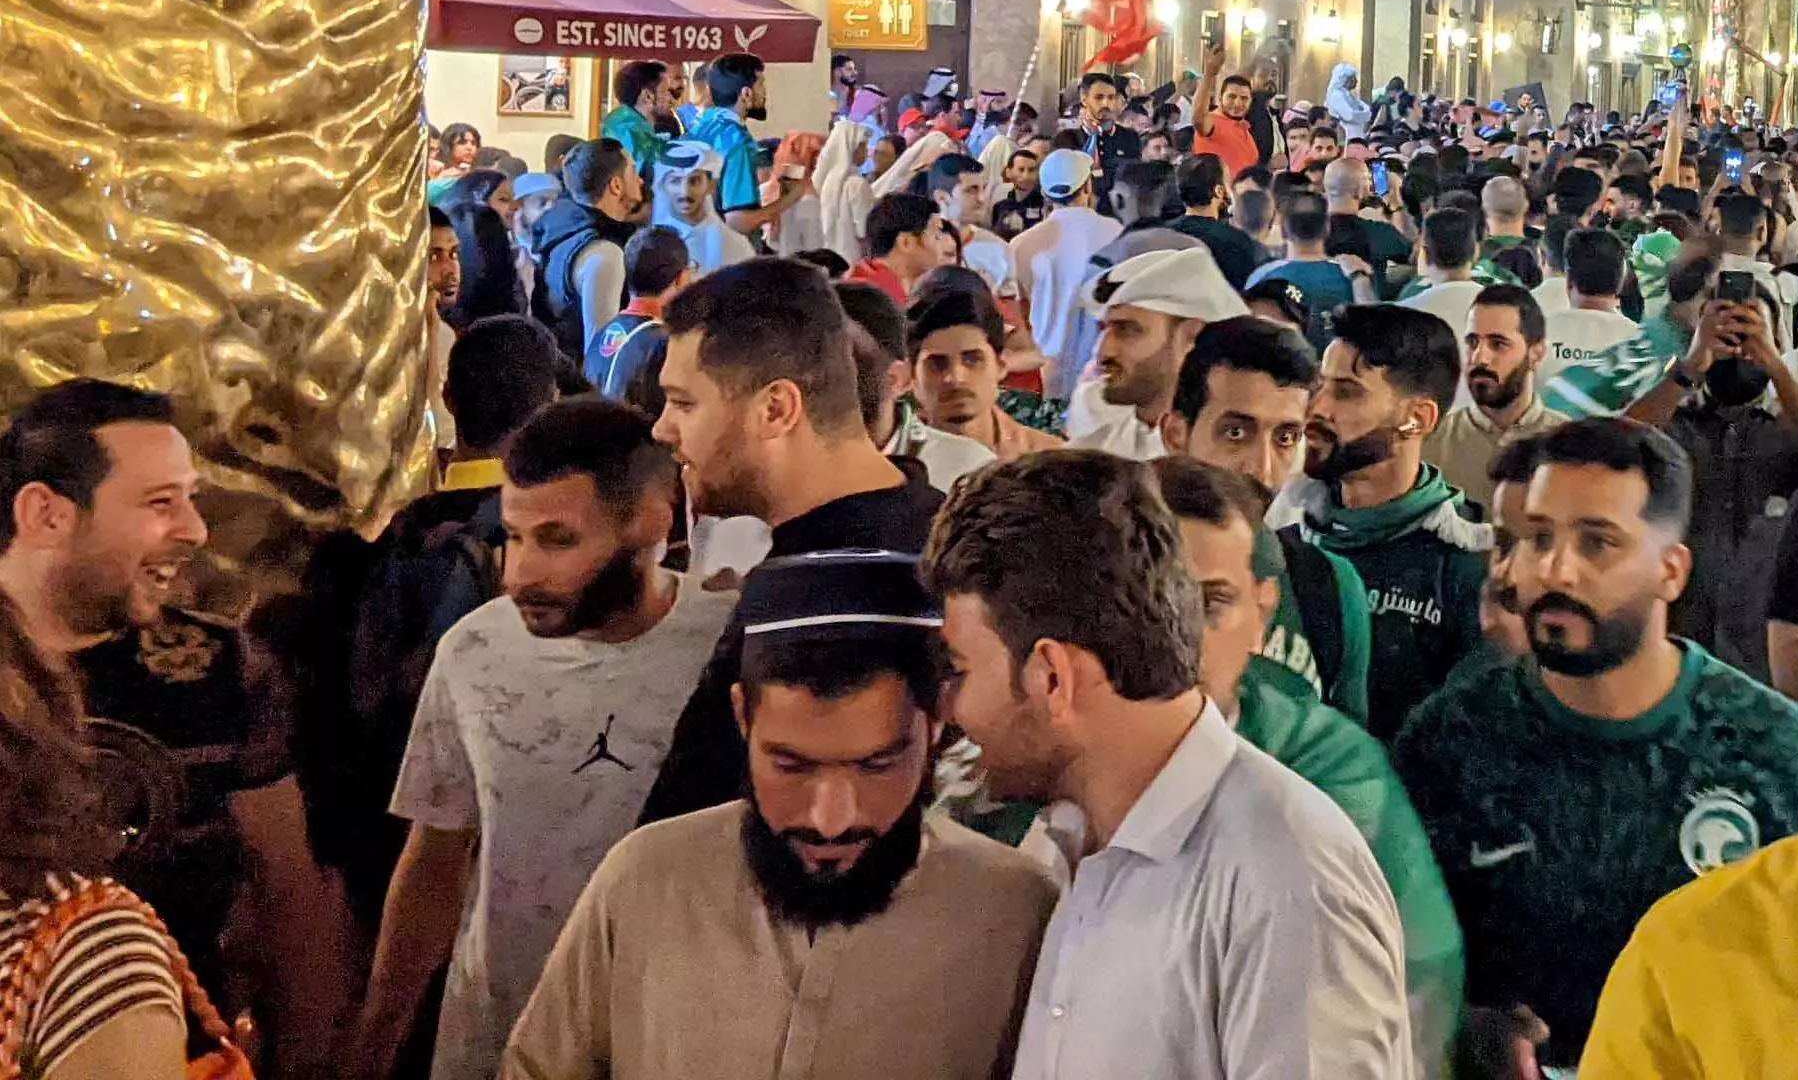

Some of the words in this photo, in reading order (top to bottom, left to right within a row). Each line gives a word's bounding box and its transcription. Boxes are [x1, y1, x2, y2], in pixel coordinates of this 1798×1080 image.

[556, 20, 599, 46] EST.
[603, 22, 667, 48] SINCE
[671, 25, 722, 51] 1963
